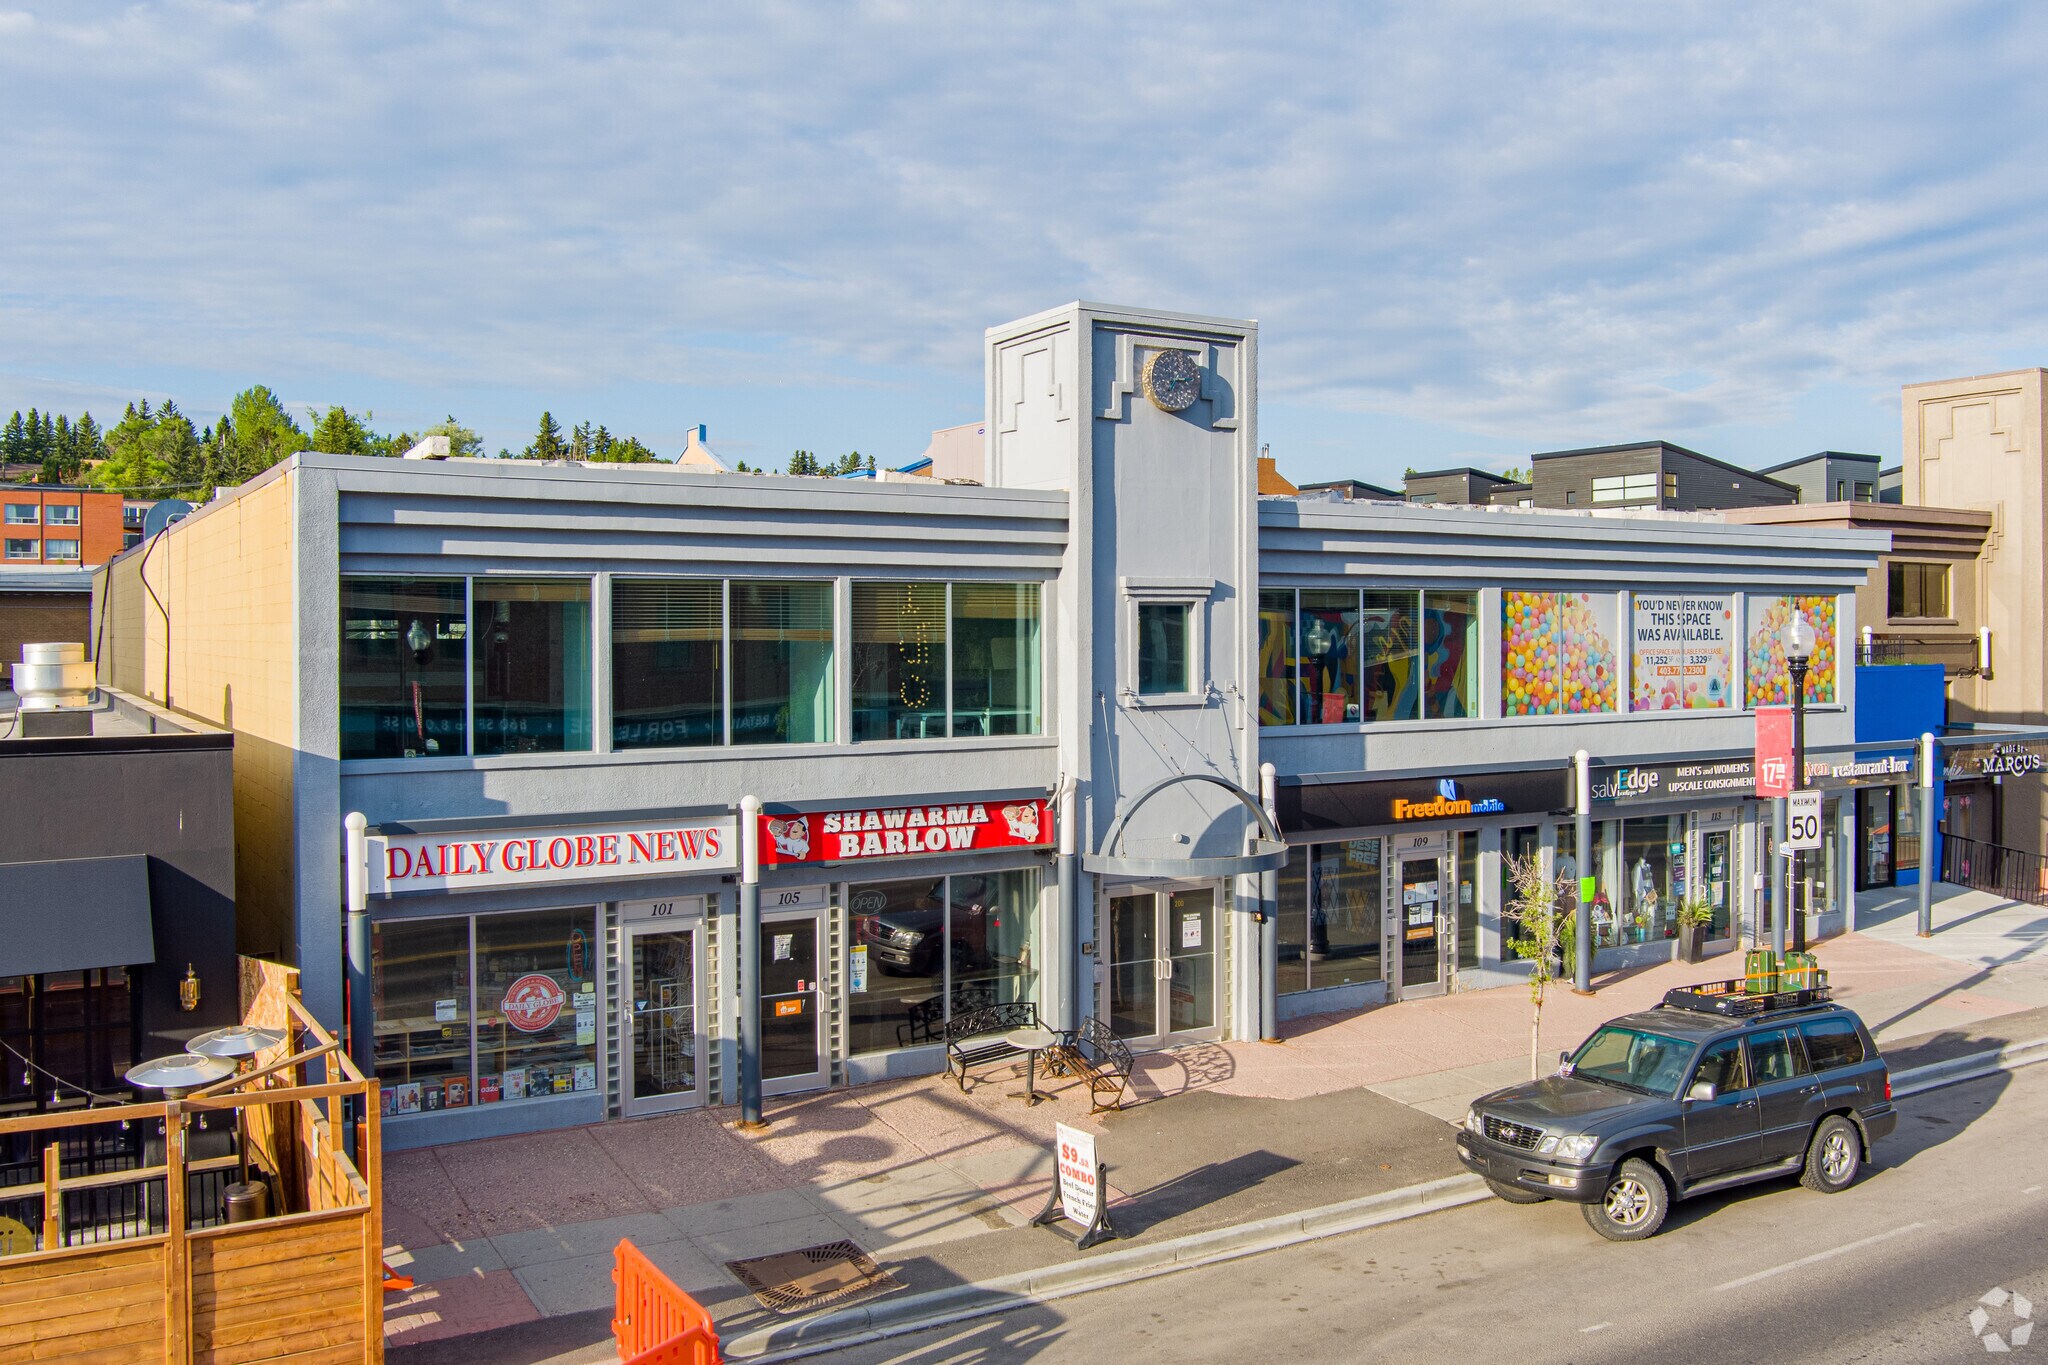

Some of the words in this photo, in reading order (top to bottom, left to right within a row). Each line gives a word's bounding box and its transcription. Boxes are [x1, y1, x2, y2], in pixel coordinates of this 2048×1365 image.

[1638, 600, 1664, 611] YOU'D
[1666, 600, 1695, 611] NEVER
[1698, 601, 1723, 611] KNOW
[1651, 613, 1675, 625] THIS
[1677, 613, 1711, 625] SPACE
[1638, 629, 1661, 641] WAS
[1663, 628, 1723, 641] AVAILABLE.
[1646, 656, 1668, 665] 11,252
[1690, 656, 1707, 665] 3,329
[1677, 766, 1702, 777] MEN'S
[1714, 763, 1750, 775] WOMEN'S
[1983, 754, 2040, 777] MARCUS
[1668, 781, 1703, 792] UPSCALE
[1705, 776, 1757, 790] CONSIGNMENT
[1393, 796, 1471, 819] Freedom
[1471, 799, 1505, 813] mobile
[1792, 798, 1817, 807] MAXIMUM
[823, 804, 989, 834] SHAWARMA
[1711, 812, 1721, 821] 113
[1791, 815, 1818, 841] 50
[839, 826, 977, 857] BARLOW
[1413, 836, 1428, 848] 109
[386, 842, 494, 880] DAILY
[501, 834, 620, 873] GLOBE
[627, 828, 722, 862] NEWS
[778, 891, 800, 905] 105
[852, 895, 883, 910] OPEN
[651, 903, 673, 916] 101
[508, 1002, 532, 1011] DAILY
[533, 996, 560, 1009] GLOBE
[1060, 1162, 1095, 1186] COMBO
[1063, 1178, 1074, 1189] Beef
[1075, 1182, 1094, 1198] Donair
[1063, 1190, 1082, 1206] French
[1073, 1207, 1089, 1219] Water
